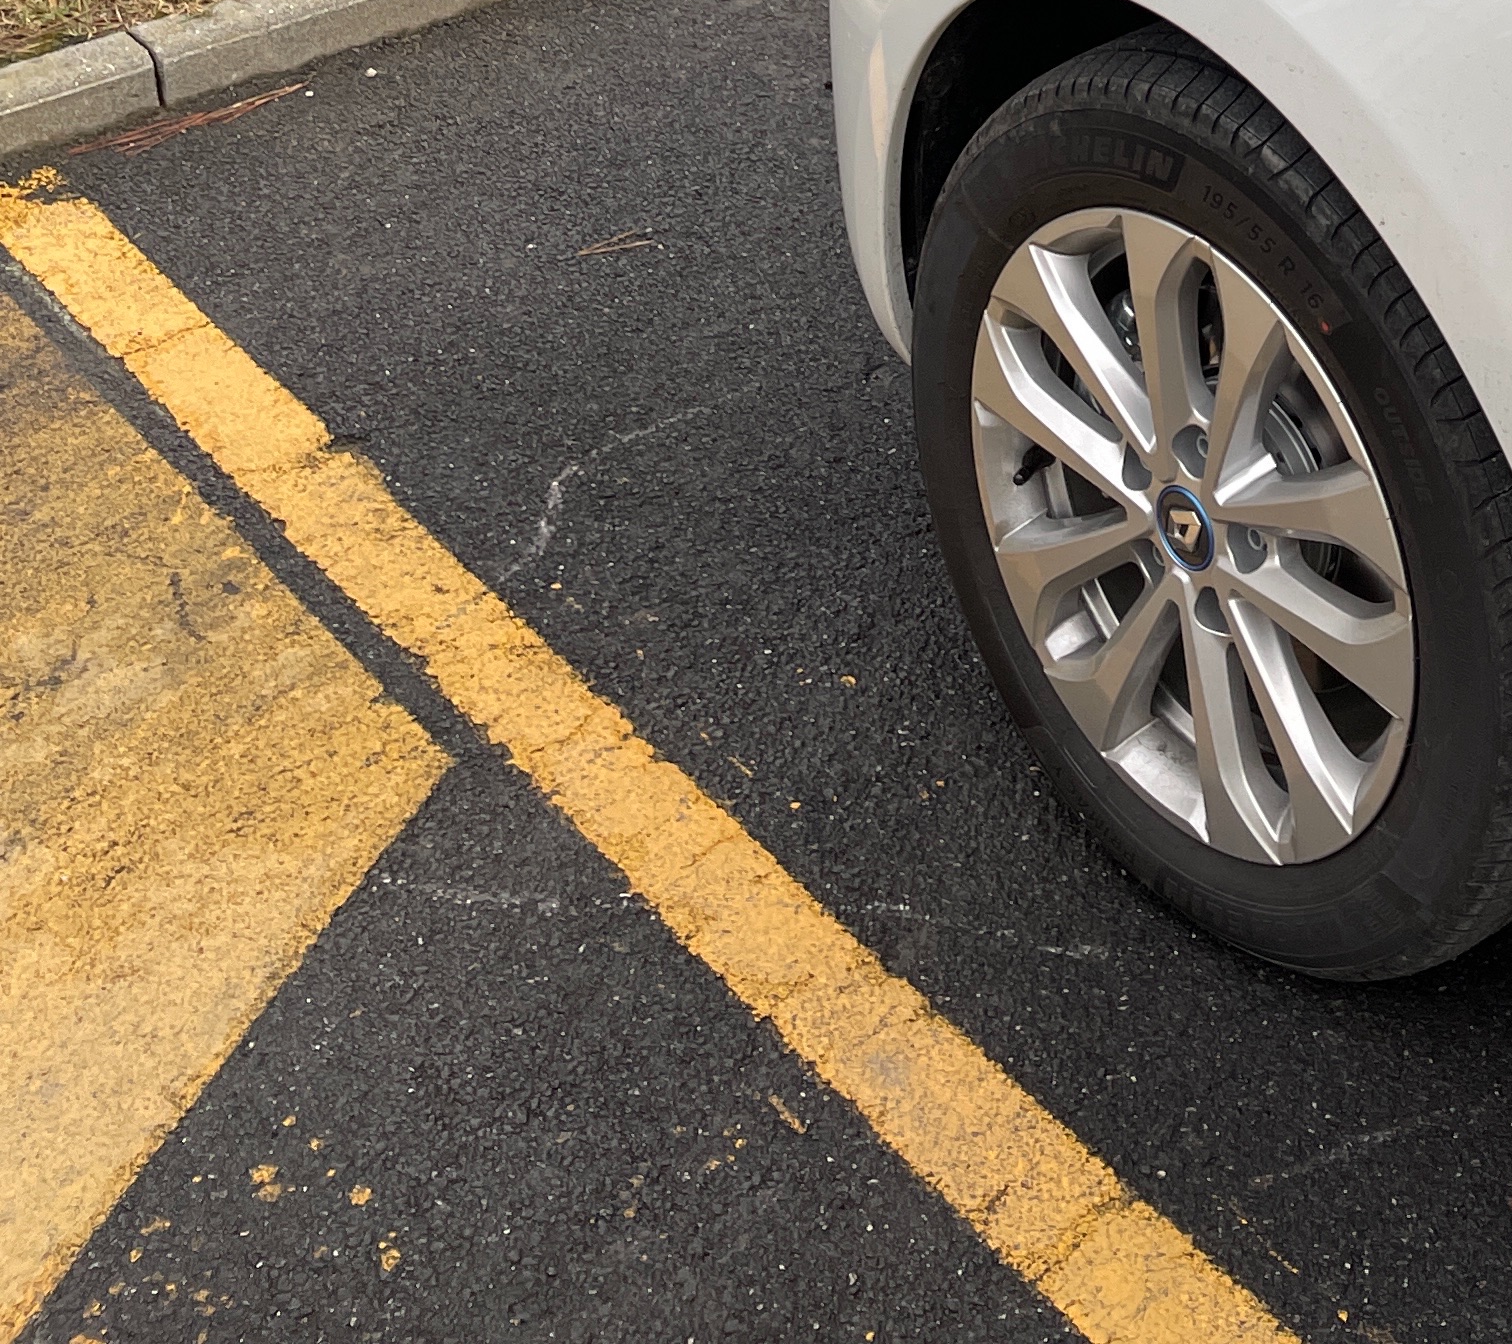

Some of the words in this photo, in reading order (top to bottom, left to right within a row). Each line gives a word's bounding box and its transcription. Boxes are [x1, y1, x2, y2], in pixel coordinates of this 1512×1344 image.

[1278, 255, 1296, 277] R
[1301, 280, 1325, 309] 16
[1373, 386, 1434, 505] OUTSIDE
